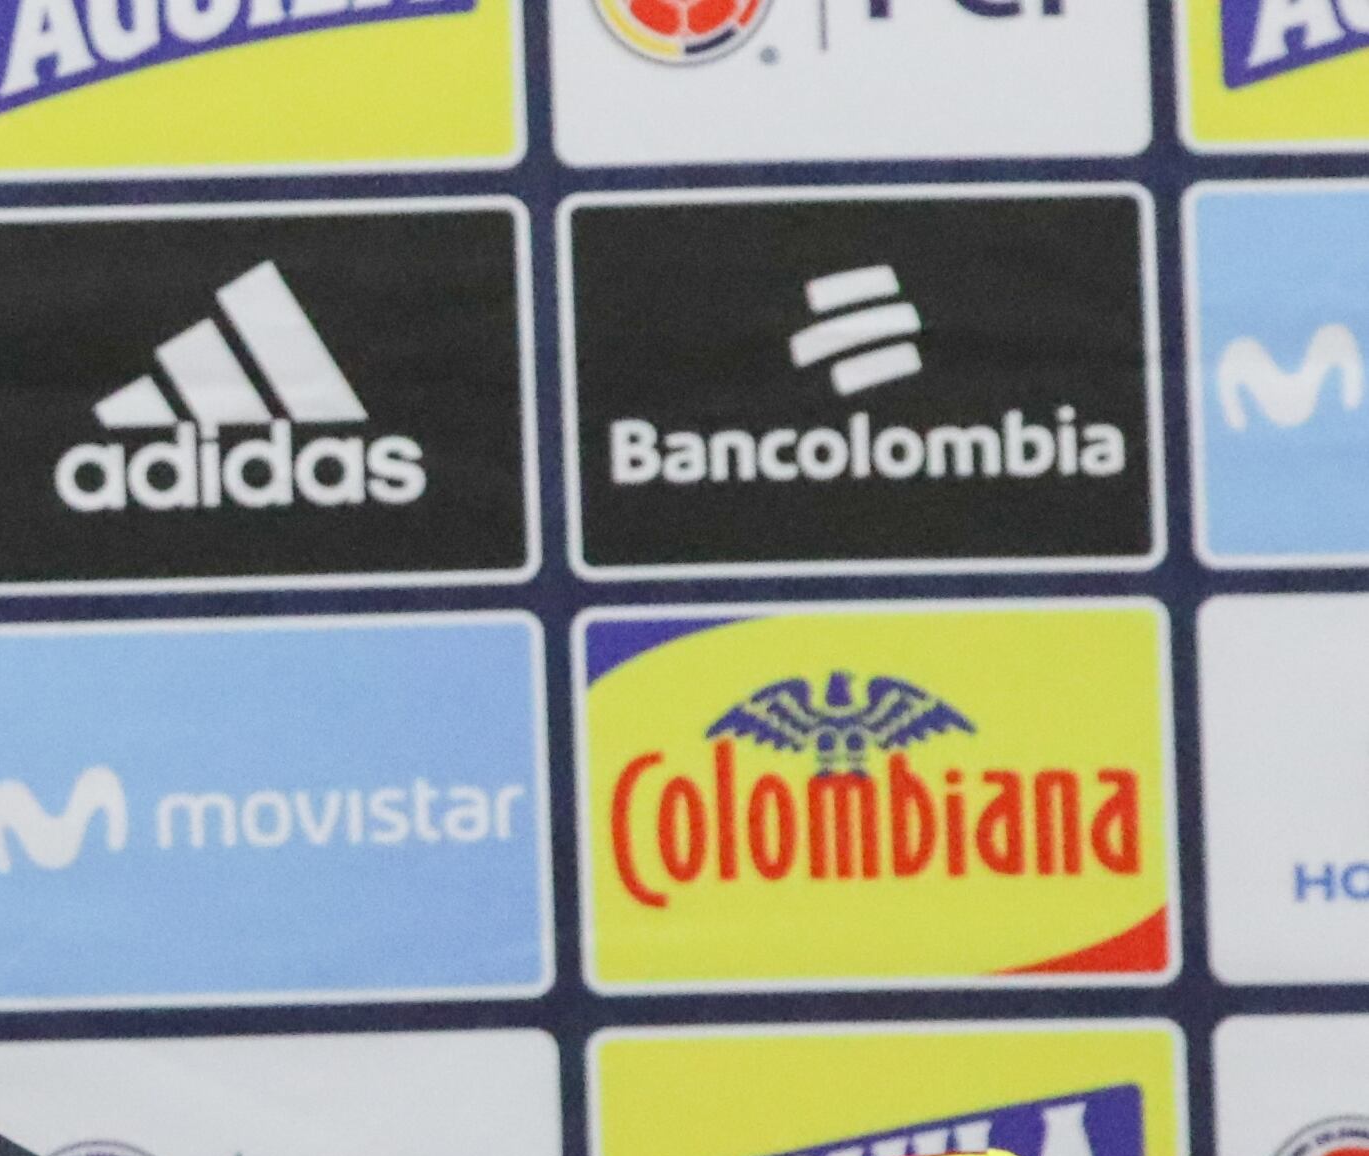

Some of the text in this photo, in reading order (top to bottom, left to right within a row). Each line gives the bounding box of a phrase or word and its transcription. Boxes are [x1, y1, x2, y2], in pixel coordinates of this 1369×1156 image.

[55, 420, 426, 511] adidas
[608, 407, 1126, 485] Bancolombia
[158, 780, 523, 851] movistar
[611, 739, 1141, 907] Colombiana
